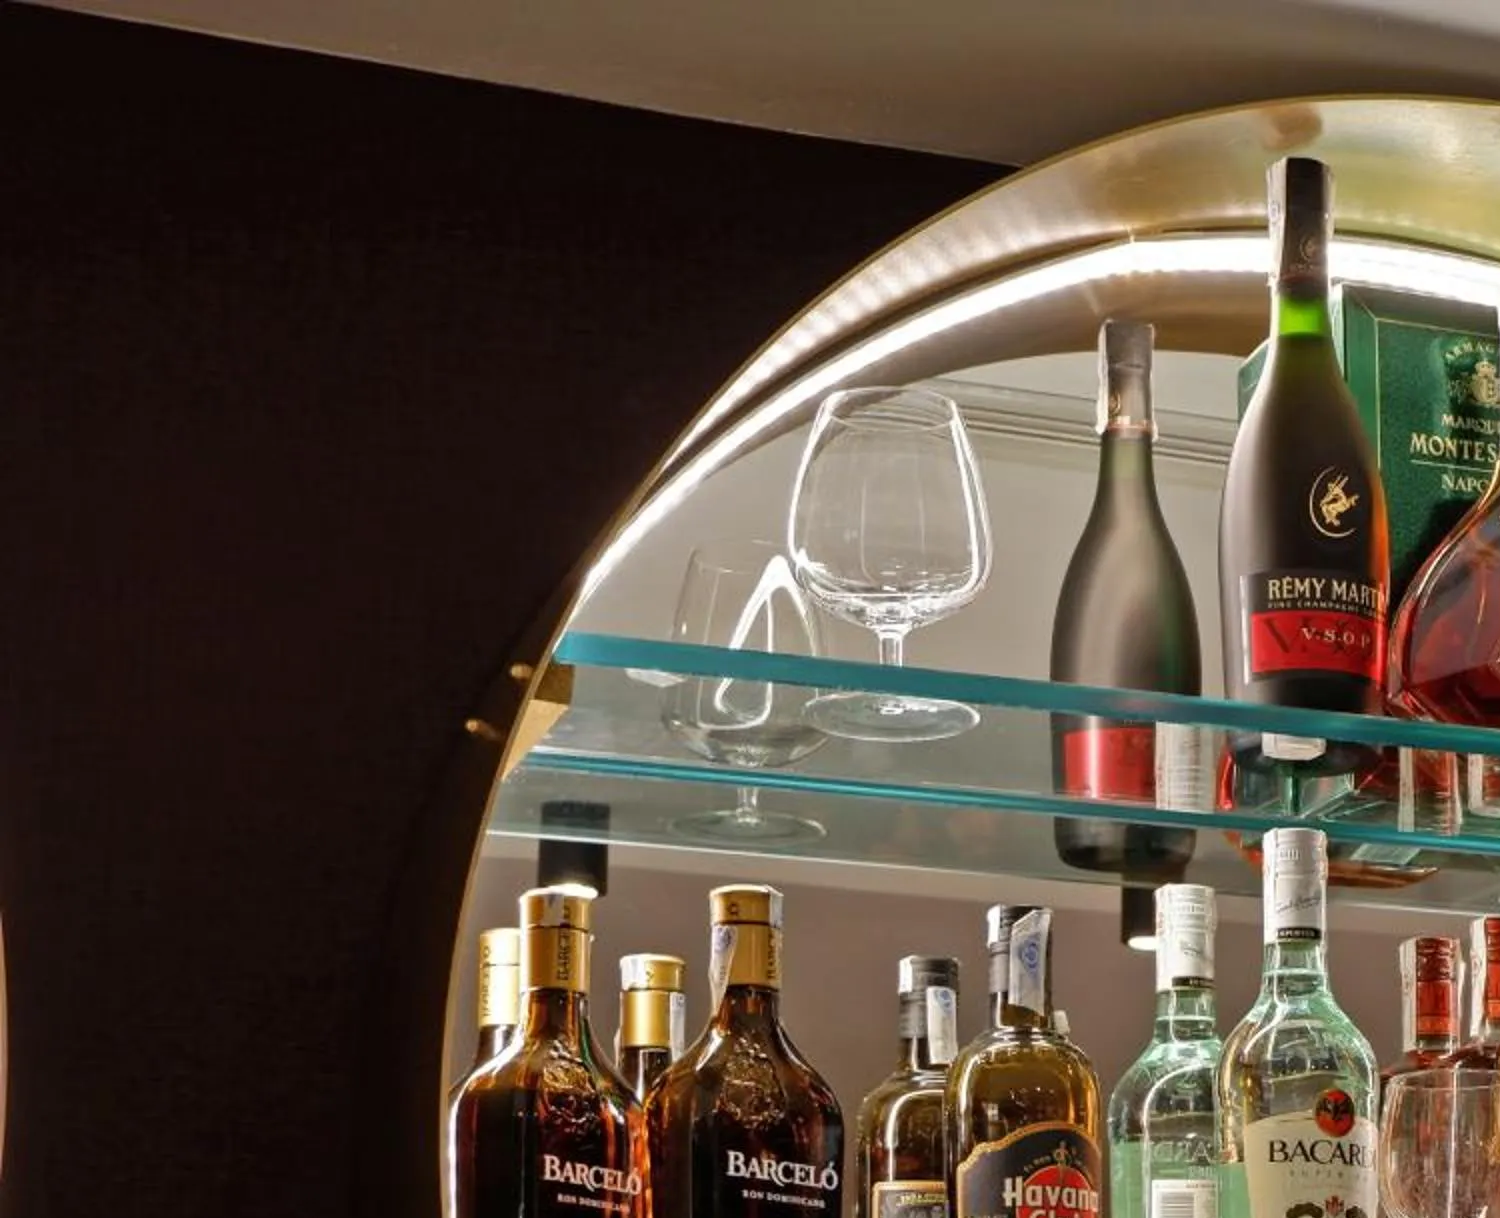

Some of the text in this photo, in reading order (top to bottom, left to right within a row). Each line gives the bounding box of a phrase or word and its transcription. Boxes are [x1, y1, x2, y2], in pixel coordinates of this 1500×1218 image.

[1446, 341, 1497, 361] ARMAG
[1409, 432, 1499, 463] MONTES
[1441, 472, 1489, 493] NAPO
[1331, 578, 1384, 609] MART
[543, 1153, 641, 1196] BARCELÓ
[726, 1149, 839, 1191] BARCELÓ
[1002, 1175, 1099, 1213] Havana
